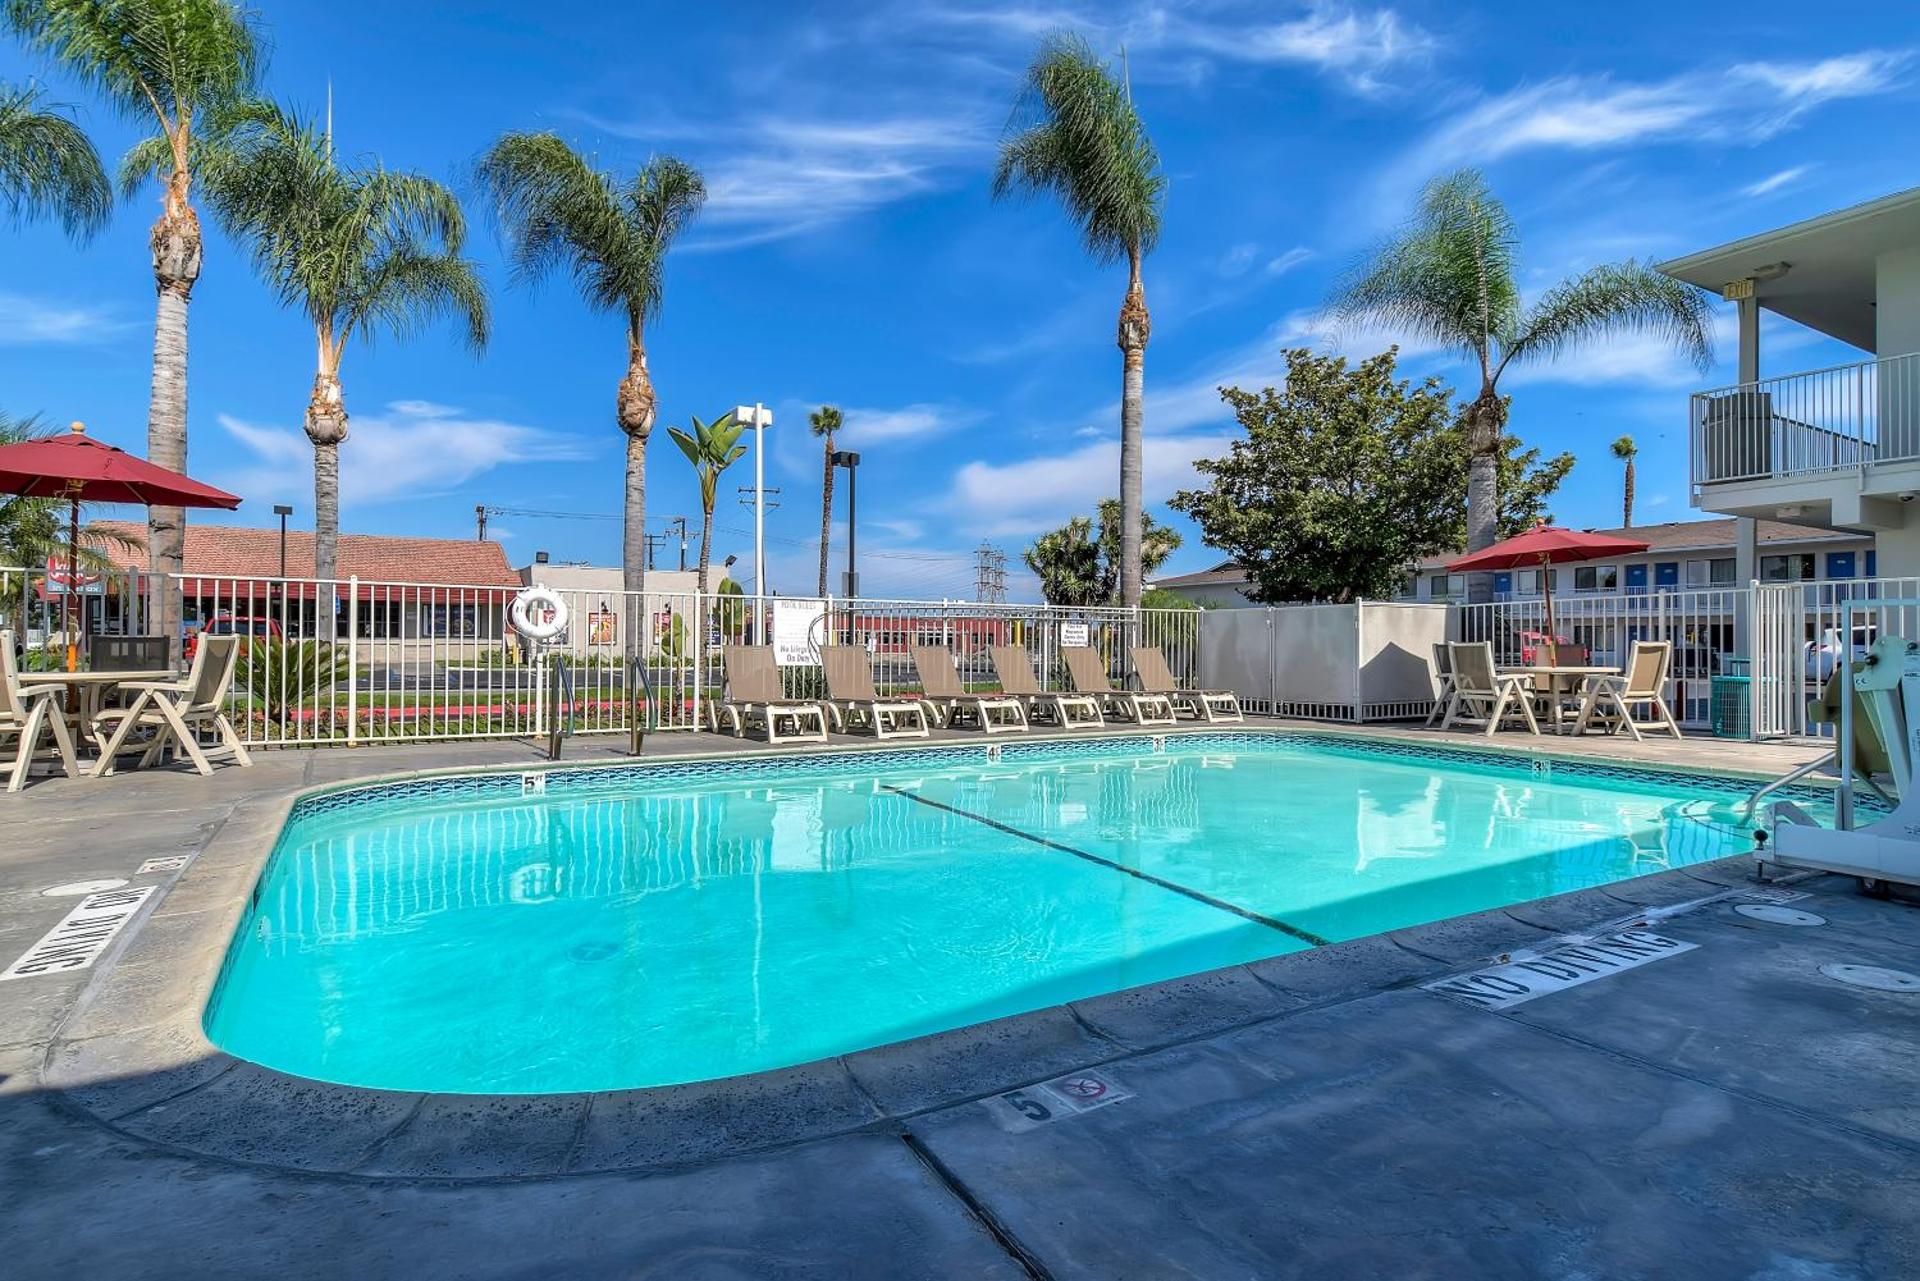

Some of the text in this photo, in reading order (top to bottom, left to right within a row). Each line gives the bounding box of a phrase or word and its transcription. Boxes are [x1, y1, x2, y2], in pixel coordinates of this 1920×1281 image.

[14, 888, 148, 974] NO DIVING
[1434, 930, 1679, 1006] NO DIVING
[1001, 1091, 1052, 1121] 5
